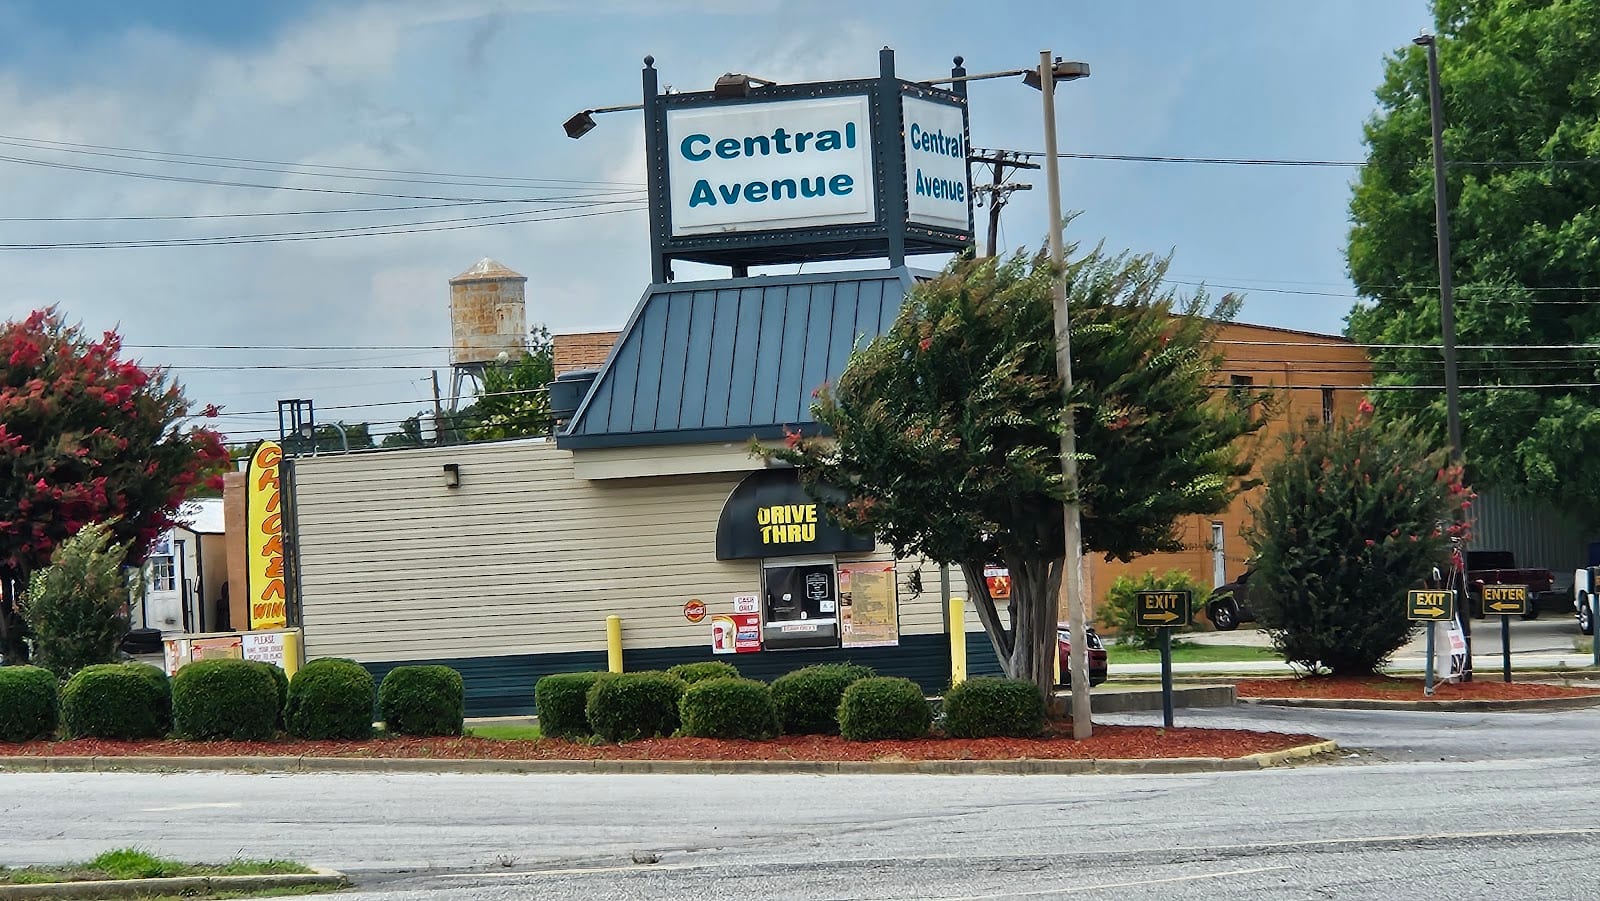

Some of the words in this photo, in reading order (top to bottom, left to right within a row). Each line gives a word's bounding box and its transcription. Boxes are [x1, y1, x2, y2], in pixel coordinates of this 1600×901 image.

[680, 121, 856, 162] Central
[910, 122, 964, 159] Central
[689, 173, 854, 208] Avenue
[915, 168, 965, 202] Avenue
[757, 503, 817, 525] DRIVE
[759, 523, 816, 544] THRU
[1145, 594, 1179, 609] EXIT
[1416, 592, 1446, 606] EXIT
[1484, 588, 1524, 600] ENTER
[254, 635, 275, 645] PLEASE
